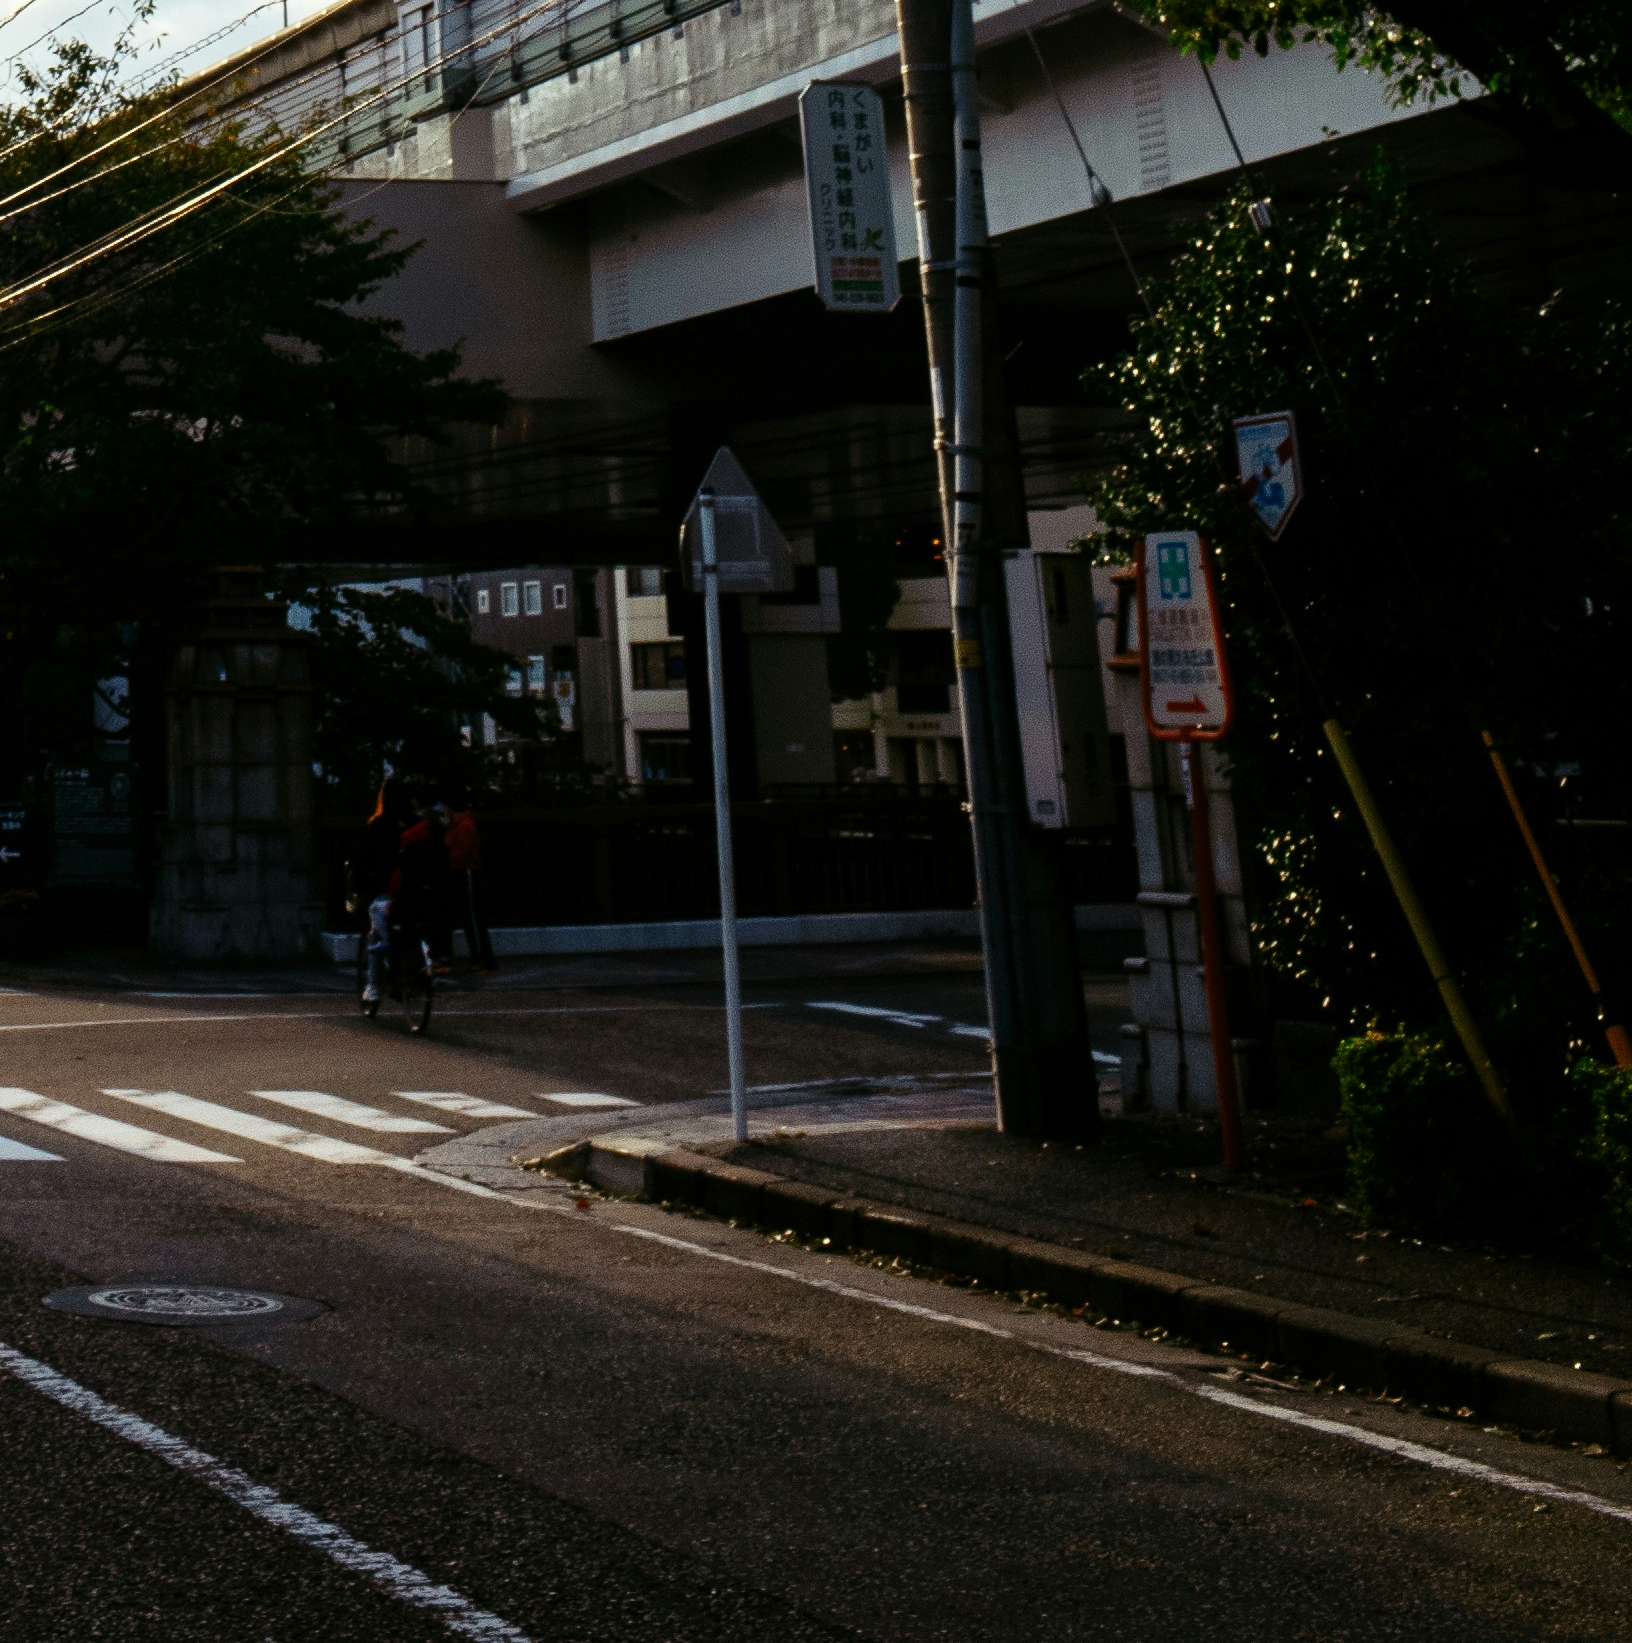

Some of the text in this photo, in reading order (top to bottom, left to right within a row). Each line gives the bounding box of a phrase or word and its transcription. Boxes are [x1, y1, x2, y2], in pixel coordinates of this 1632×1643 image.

[827, 89, 858, 251] 内科・脳神経内科
[852, 90, 874, 174] くまがい
[820, 183, 836, 252] クリニック
